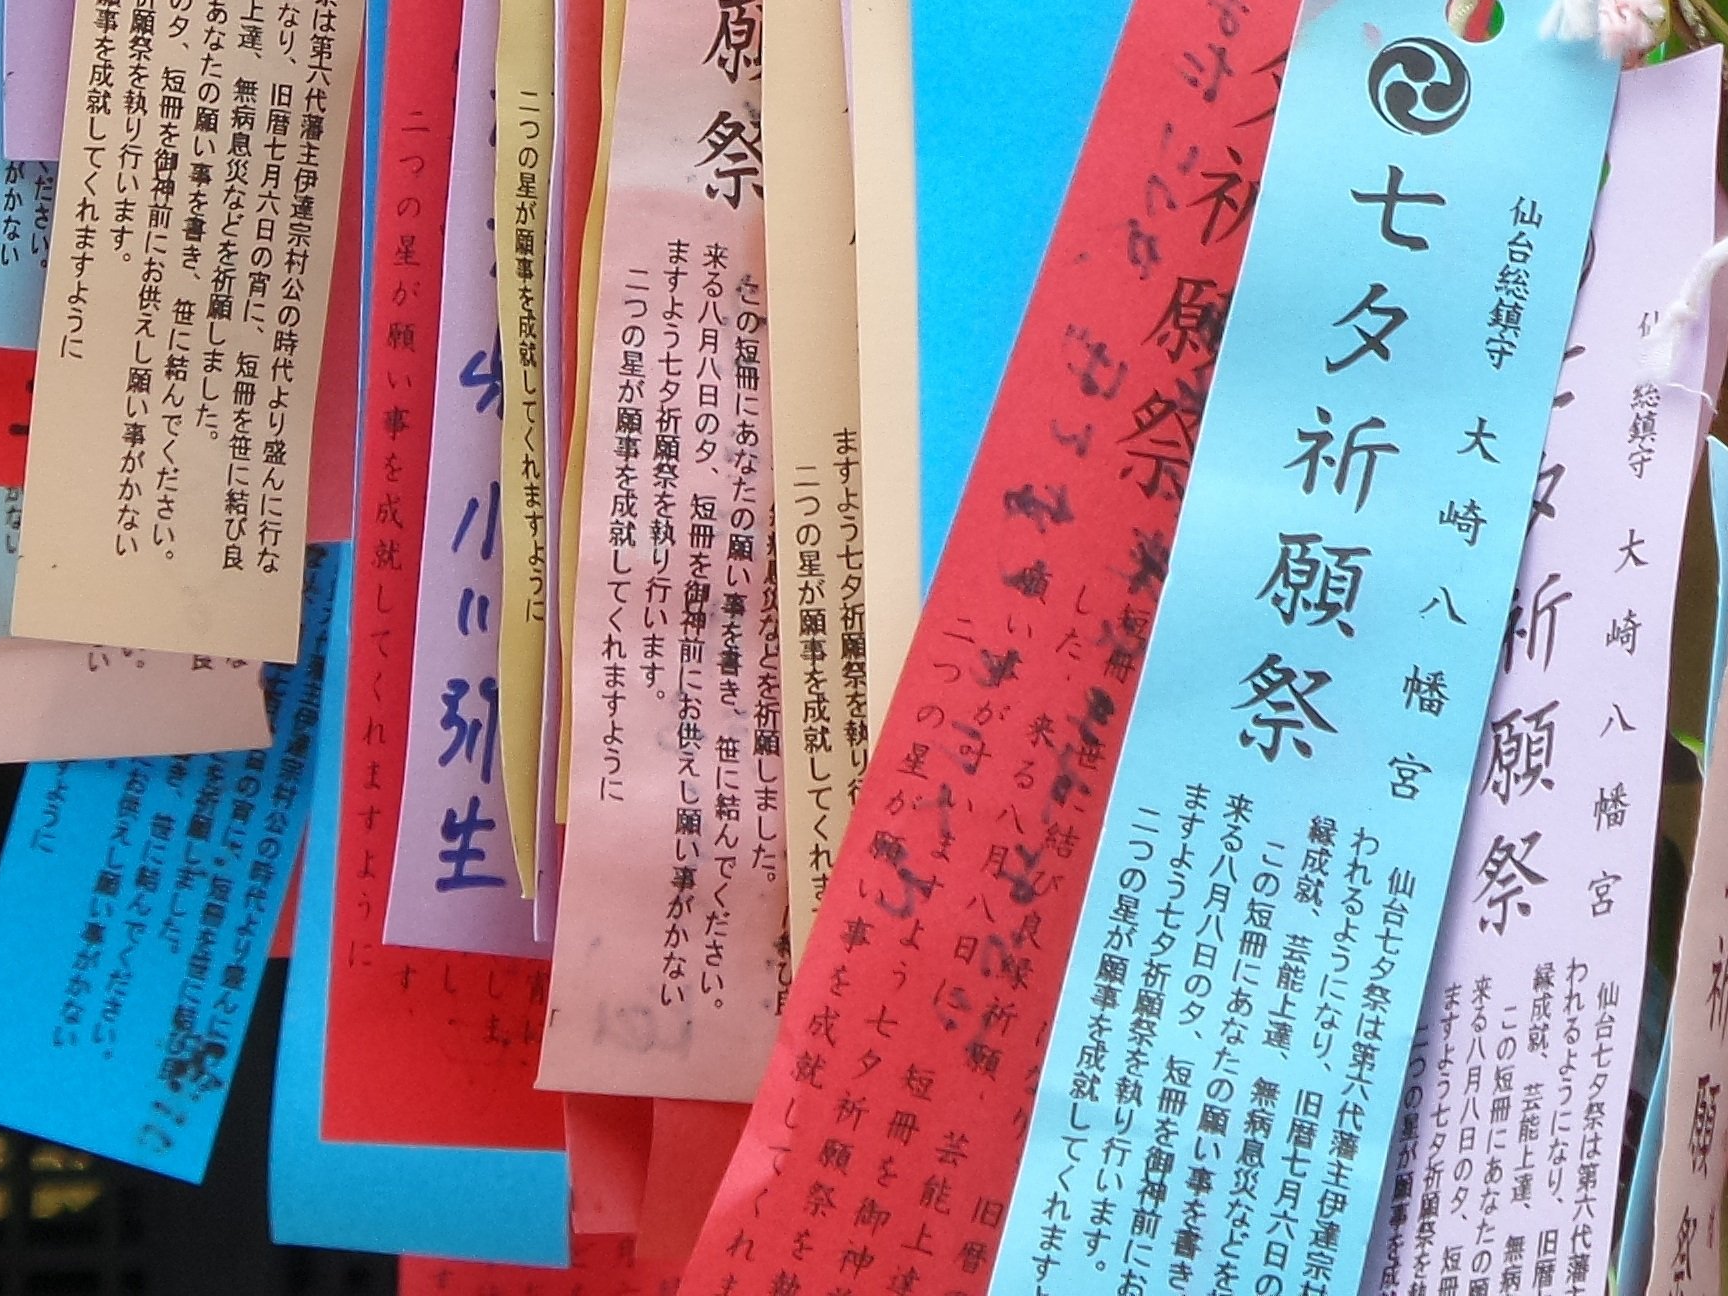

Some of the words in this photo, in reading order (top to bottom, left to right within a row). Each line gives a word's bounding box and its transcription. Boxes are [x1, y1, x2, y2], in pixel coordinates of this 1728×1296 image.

[1231, 164, 1446, 763] 七夕祈願祭
[1484, 194, 1544, 371] 仙台総鎮守
[1628, 309, 1662, 480] 仙総鎮守
[1387, 416, 1501, 803] 大崎八幡宮
[1587, 527, 1649, 919] 大崎八幡宮
